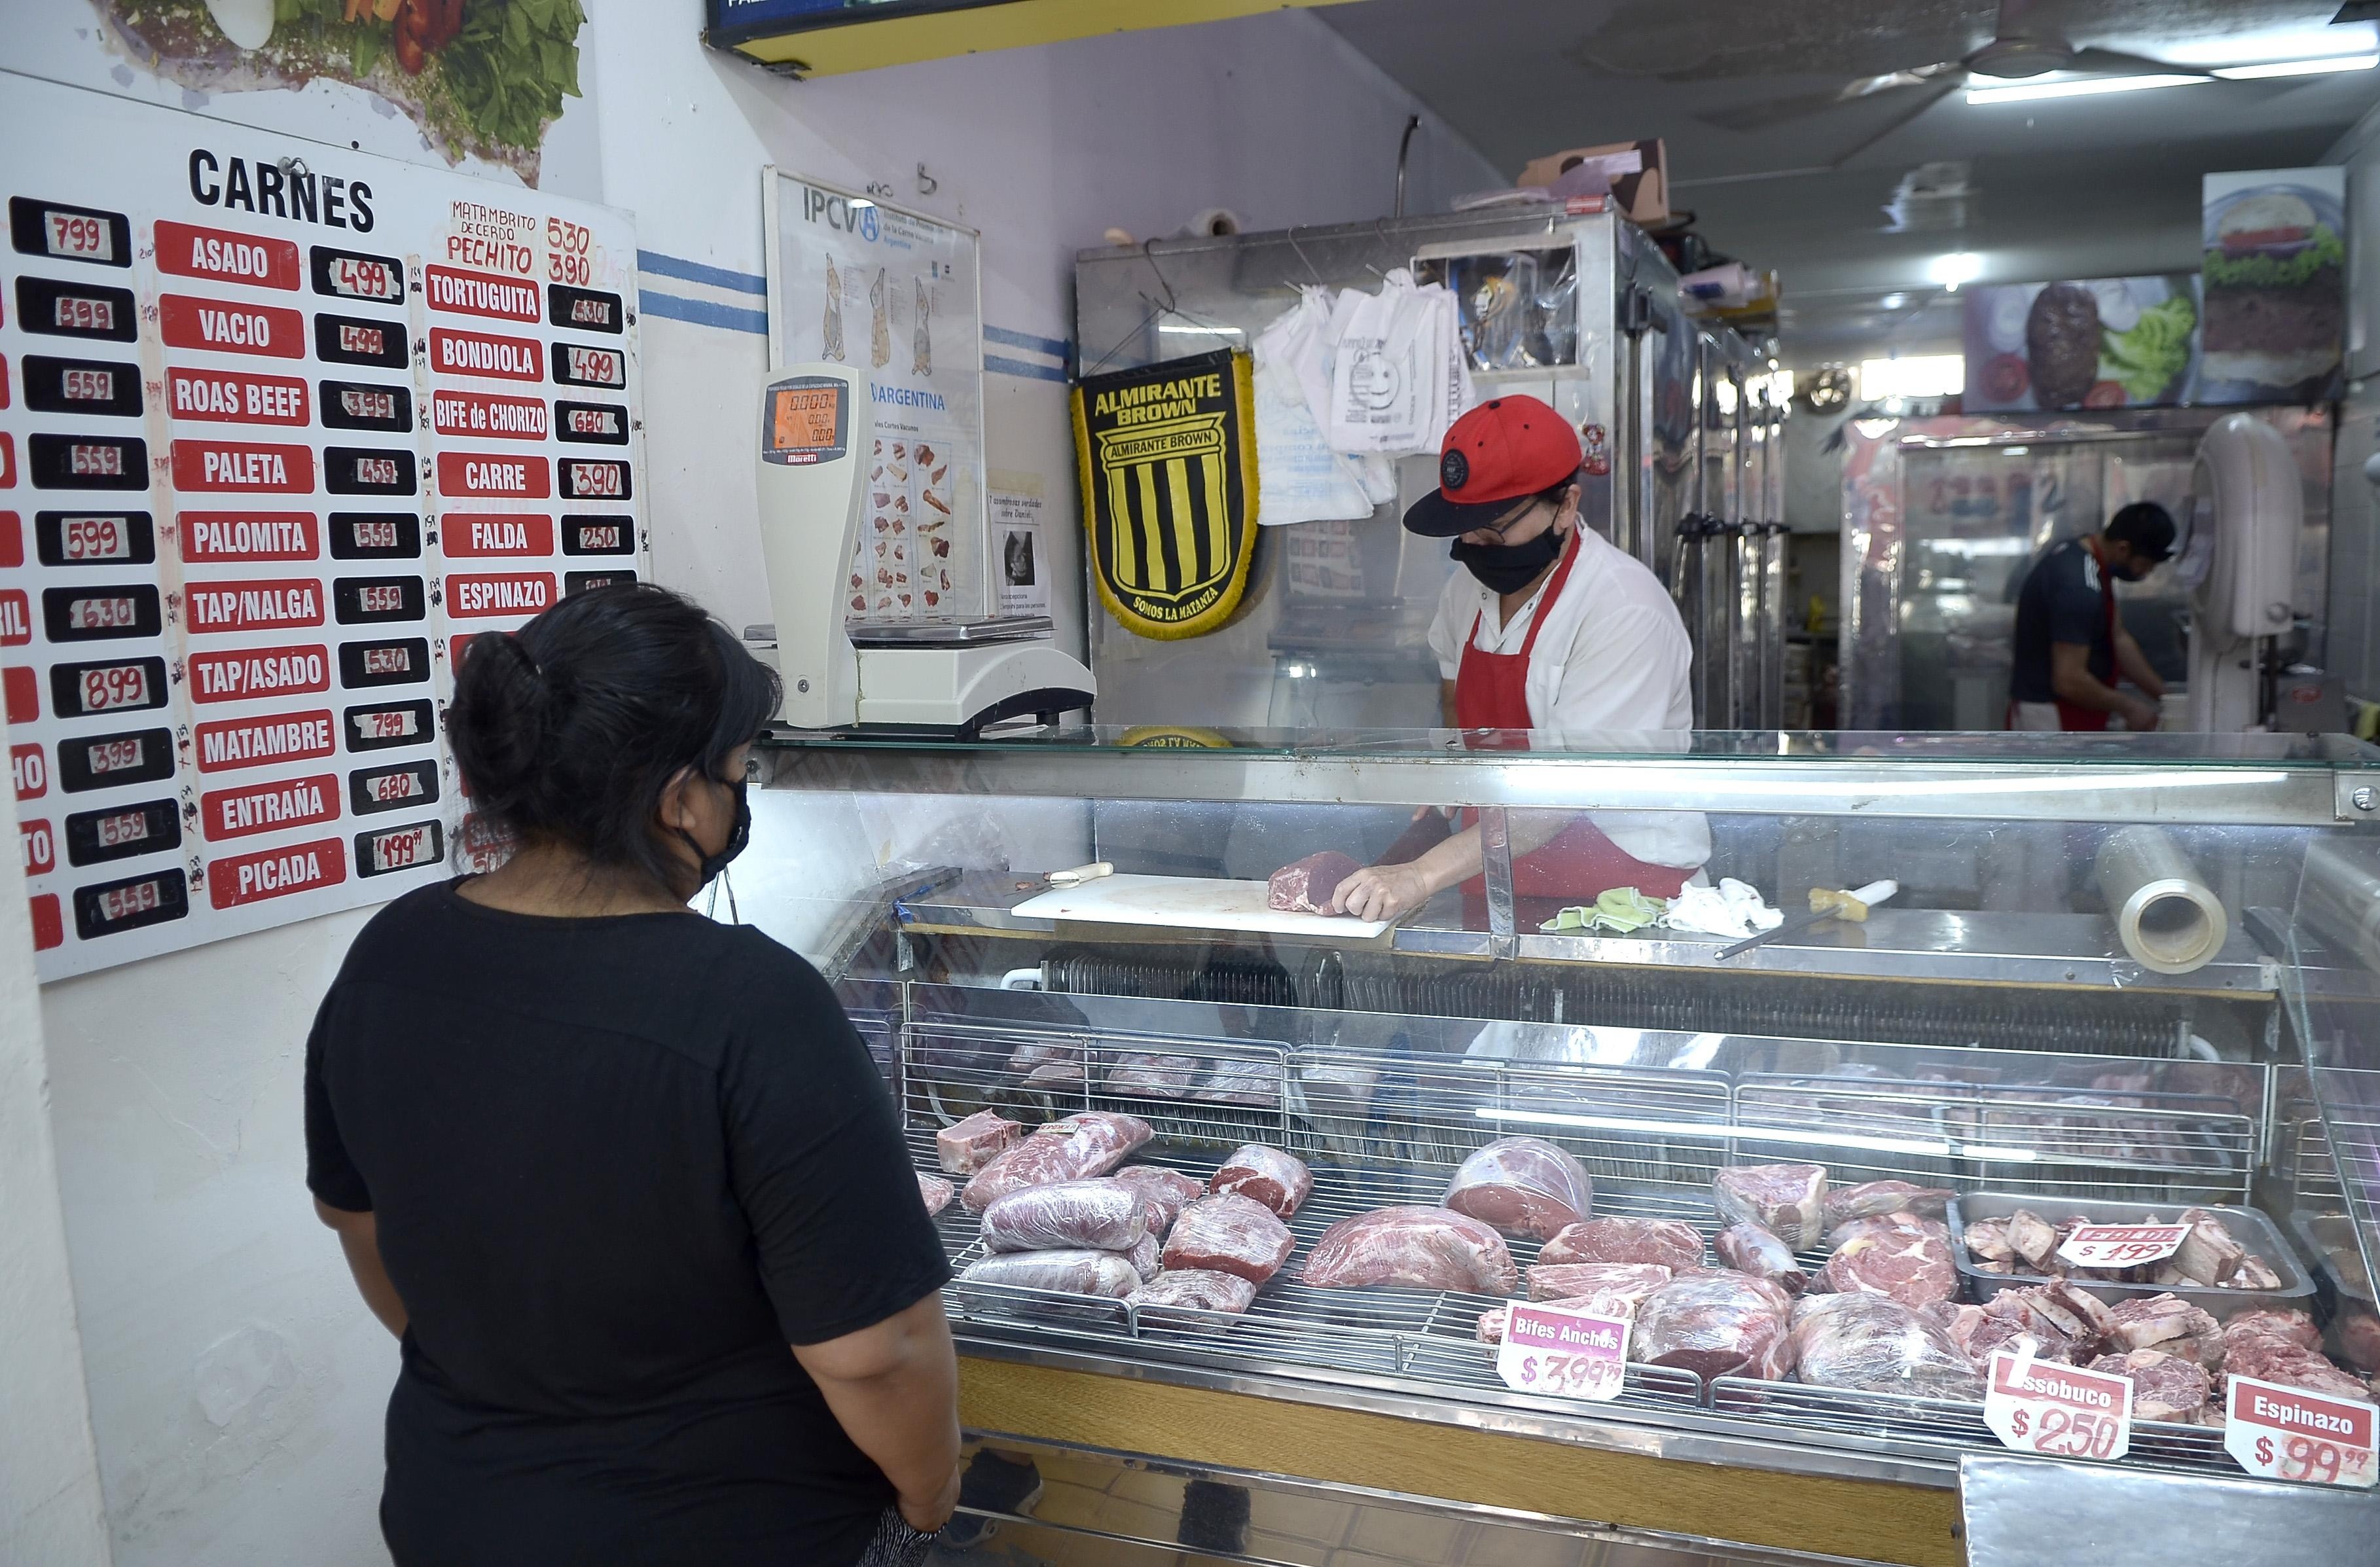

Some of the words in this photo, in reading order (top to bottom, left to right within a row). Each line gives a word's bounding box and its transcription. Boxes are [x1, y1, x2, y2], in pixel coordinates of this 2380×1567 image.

[189, 149, 375, 234] CARNES
[452, 202, 536, 230] MATAMBRITO
[461, 221, 473, 233] DE
[476, 224, 515, 241] CERDO
[803, 187, 880, 242] IPCVA
[53, 217, 101, 251] 799
[547, 217, 590, 255] 530
[192, 238, 268, 278] ASADO
[448, 236, 533, 274] PECHITO
[548, 253, 590, 287] 390
[340, 261, 386, 296] 499
[431, 274, 537, 316] TORTUGUITA
[60, 298, 109, 329] 599
[199, 308, 270, 348] VACIO
[343, 327, 383, 354] 499
[442, 338, 534, 375] BONDIOLA
[574, 351, 614, 382] 499
[66, 372, 109, 400] 559
[175, 378, 242, 414] ROAS
[247, 384, 301, 418] BEEF
[878, 386, 945, 410] ARGENTINA
[1095, 373, 1221, 416] ALMIRANTE
[348, 393, 390, 417] 399
[436, 399, 467, 428] BIFE
[471, 402, 486, 429] de
[490, 403, 546, 433] CHORIZO
[1117, 399, 1197, 426] BROWN
[575, 411, 604, 433] 680
[74, 445, 119, 474] 559
[787, 454, 817, 463] Moretti
[1111, 438, 1166, 458] ALMIRANTE
[1170, 431, 1212, 448] BROWN
[204, 452, 287, 484] PALETA
[361, 459, 394, 483] 459
[465, 462, 526, 491] CARRE
[576, 465, 618, 494] 390
[1021, 499, 1041, 509] verdades
[69, 521, 118, 558] 599
[194, 522, 306, 552] PALOMITA
[359, 523, 393, 547] 559
[472, 523, 528, 549] FALDA
[583, 527, 616, 548] 250
[192, 589, 317, 624] TAP/NALGA
[367, 586, 401, 611] 559
[459, 581, 546, 610] ESPINAZO
[1133, 596, 1163, 620] SOMOS
[1165, 605, 1178, 621] LA
[1178, 587, 1218, 619] MATANZA
[84, 598, 131, 627] 630
[198, 654, 321, 694] TAP/ASADO
[367, 649, 406, 673] 530
[86, 667, 142, 708] 899
[204, 718, 329, 764] MATAMBRE
[372, 713, 404, 737] 799
[93, 740, 137, 773] 399
[378, 773, 410, 800] 680
[222, 780, 324, 830] ENTRAÑA
[104, 812, 144, 845] 559
[239, 852, 321, 896] PICADA
[108, 883, 156, 916] 559
[1515, 1317, 1556, 1339] Bifes
[1559, 1325, 1619, 1350] Anchos
[1521, 1356, 1538, 1385] $
[2019, 1373, 2113, 1409] ssobuco
[2253, 1396, 2354, 1436] Espinazo
[2011, 1408, 2030, 1439] $
[2035, 1408, 2119, 1460] 250
[2255, 1436, 2273, 1467] $
[2281, 1436, 2342, 1483] 99
